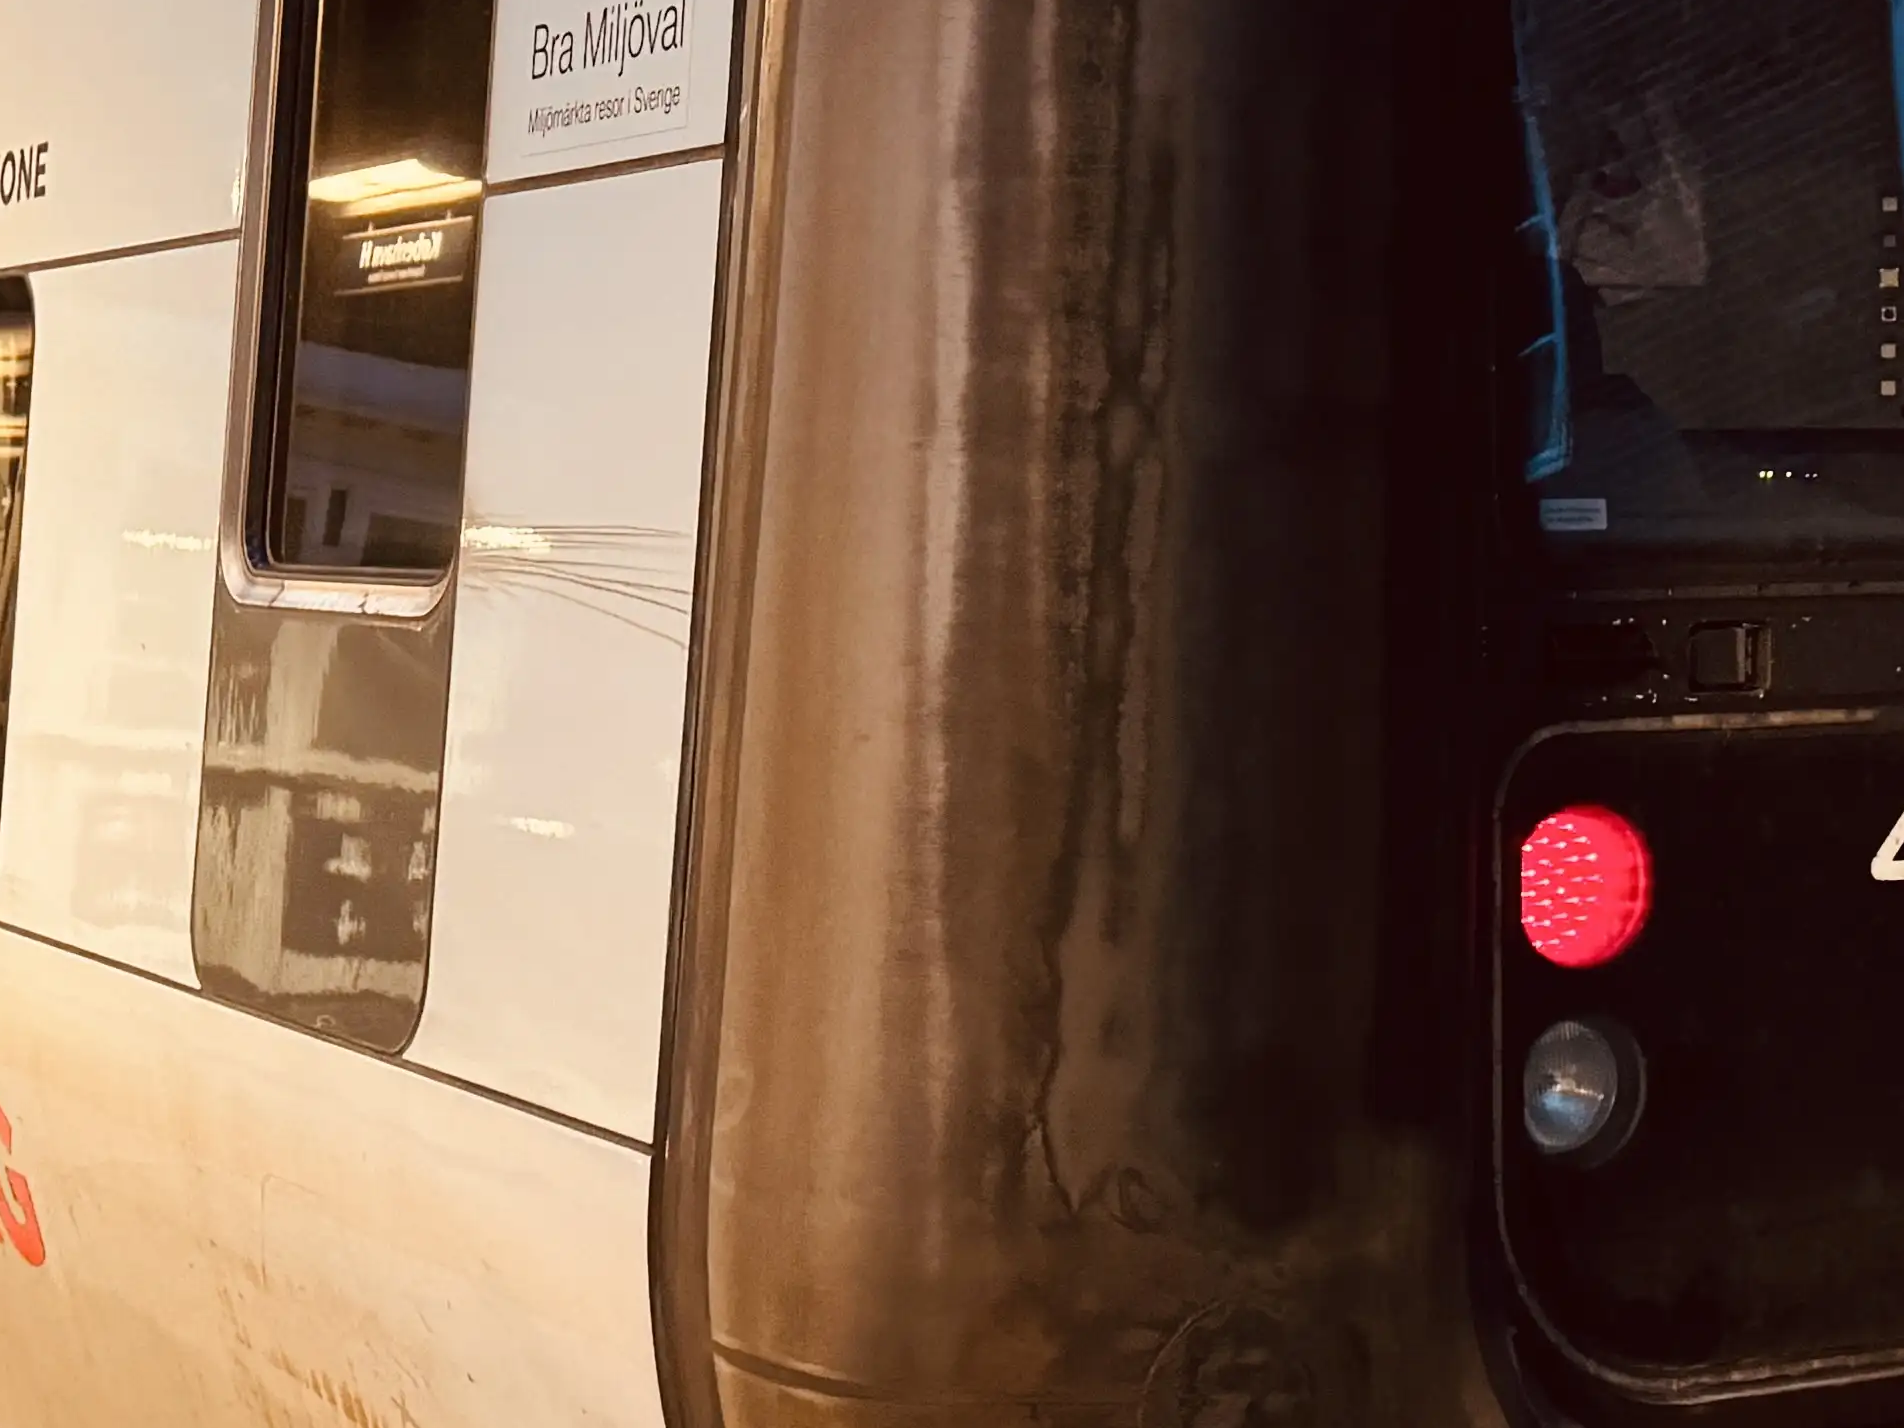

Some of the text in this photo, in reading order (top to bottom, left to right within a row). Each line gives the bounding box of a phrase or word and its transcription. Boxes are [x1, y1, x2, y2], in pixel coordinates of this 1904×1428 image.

[531, 23, 574, 80] Bra
[527, 100, 592, 138] Miljömärkta
[593, 96, 625, 121] resor
[633, 84, 682, 114] Sverige
